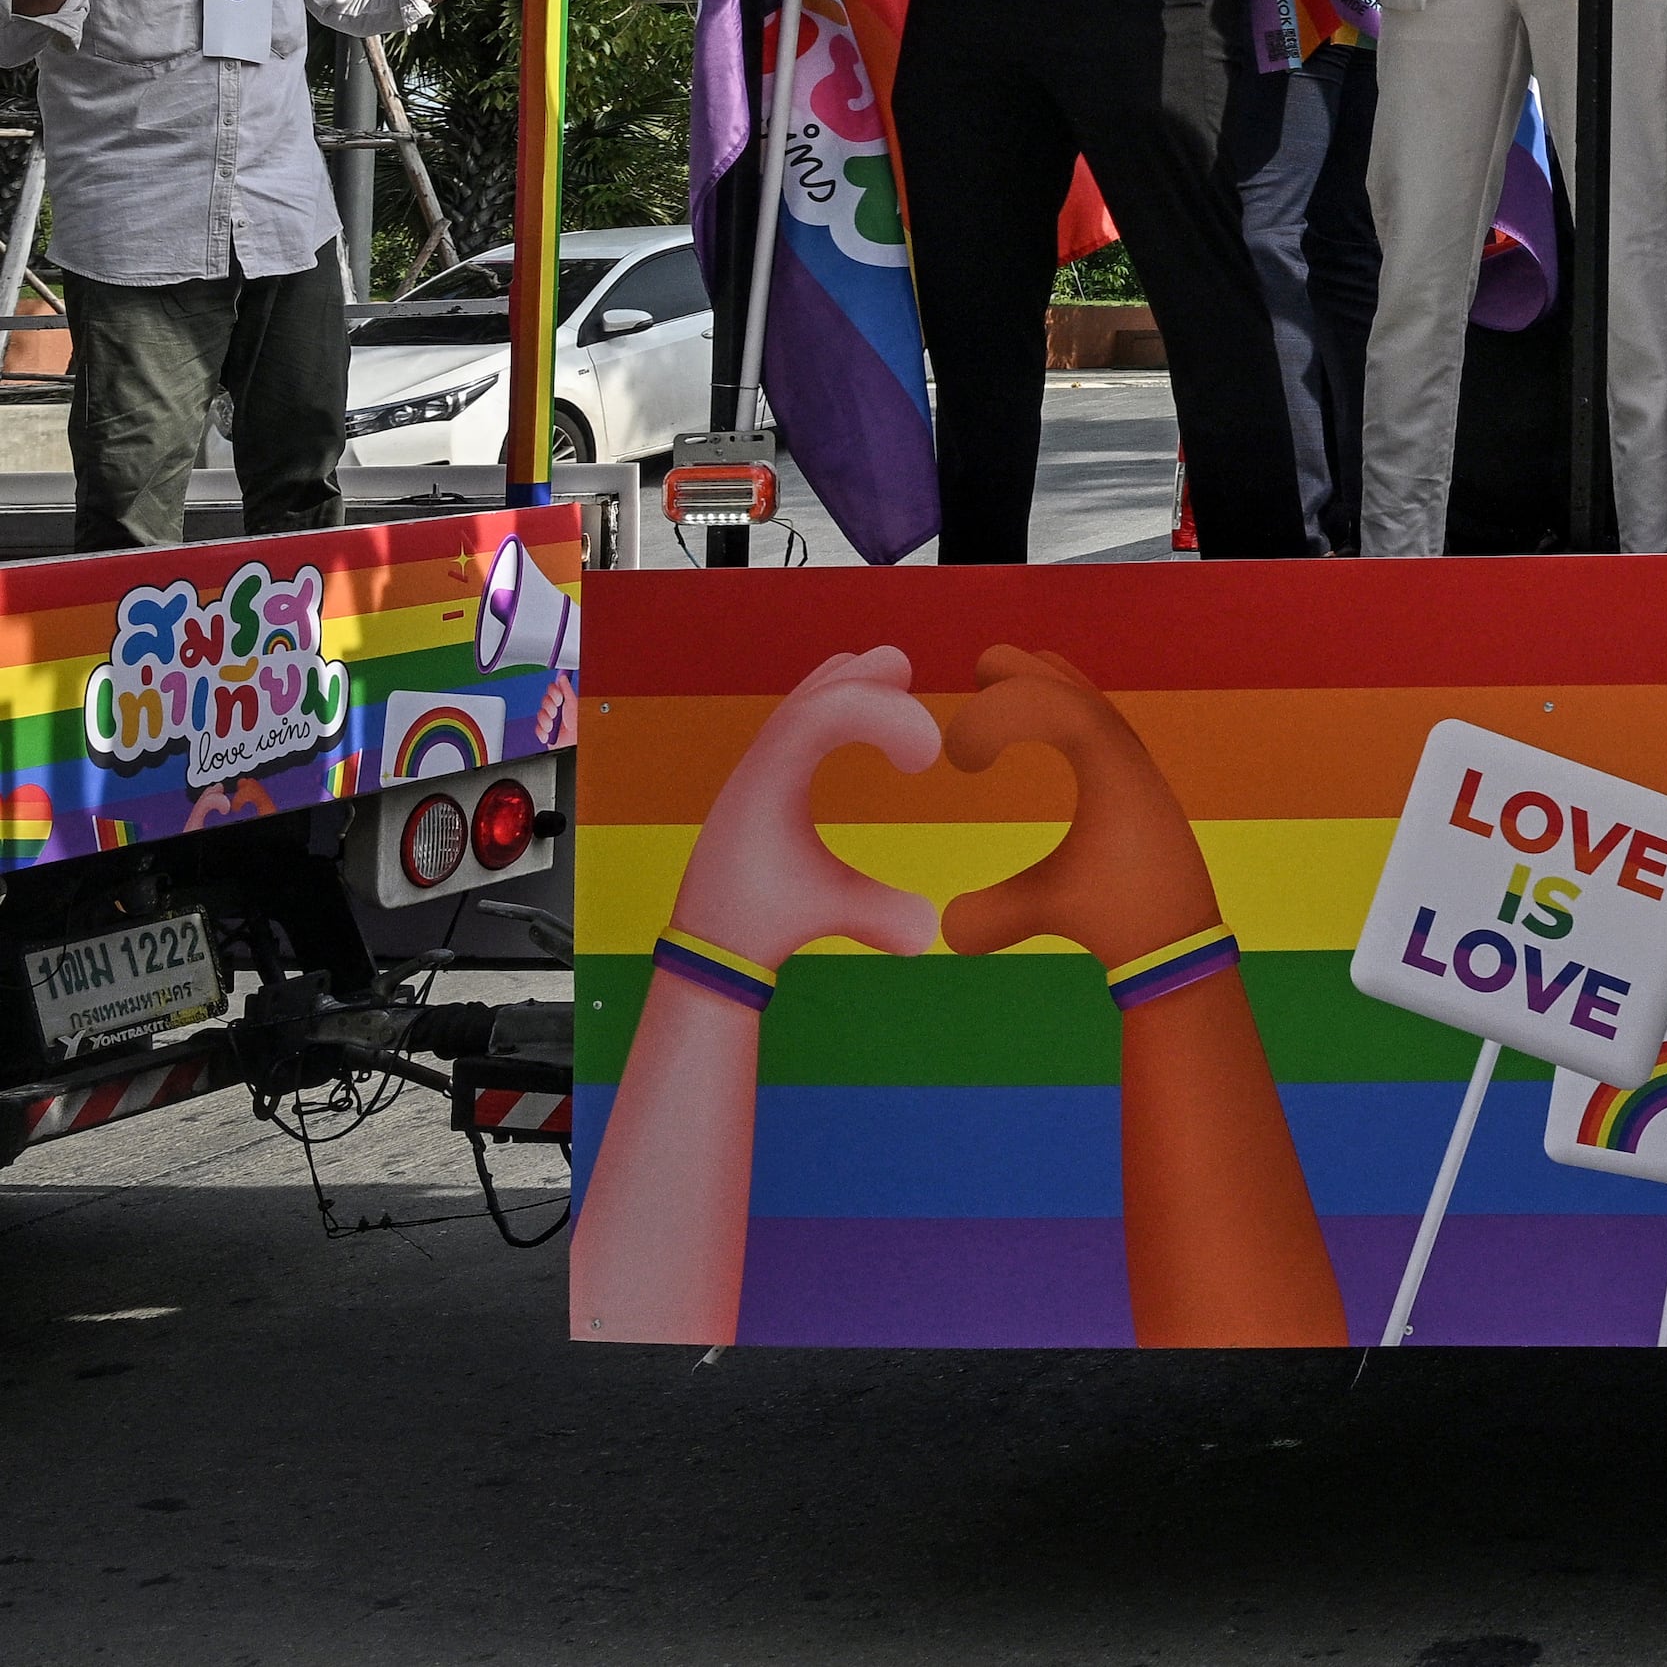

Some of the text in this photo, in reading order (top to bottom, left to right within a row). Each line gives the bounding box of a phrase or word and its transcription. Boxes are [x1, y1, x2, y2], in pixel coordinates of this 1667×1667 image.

[123, 574, 314, 666] สมรส
[99, 656, 341, 749] เท่าเทียม
[195, 717, 312, 776] love wins
[1497, 863, 1582, 940] IS
[120, 920, 206, 978] 1222
[1401, 905, 1632, 1041] LOVE
[69, 980, 194, 1033] กรุงเทพมหานคร
[89, 1018, 168, 1051] YONTRAKIT
